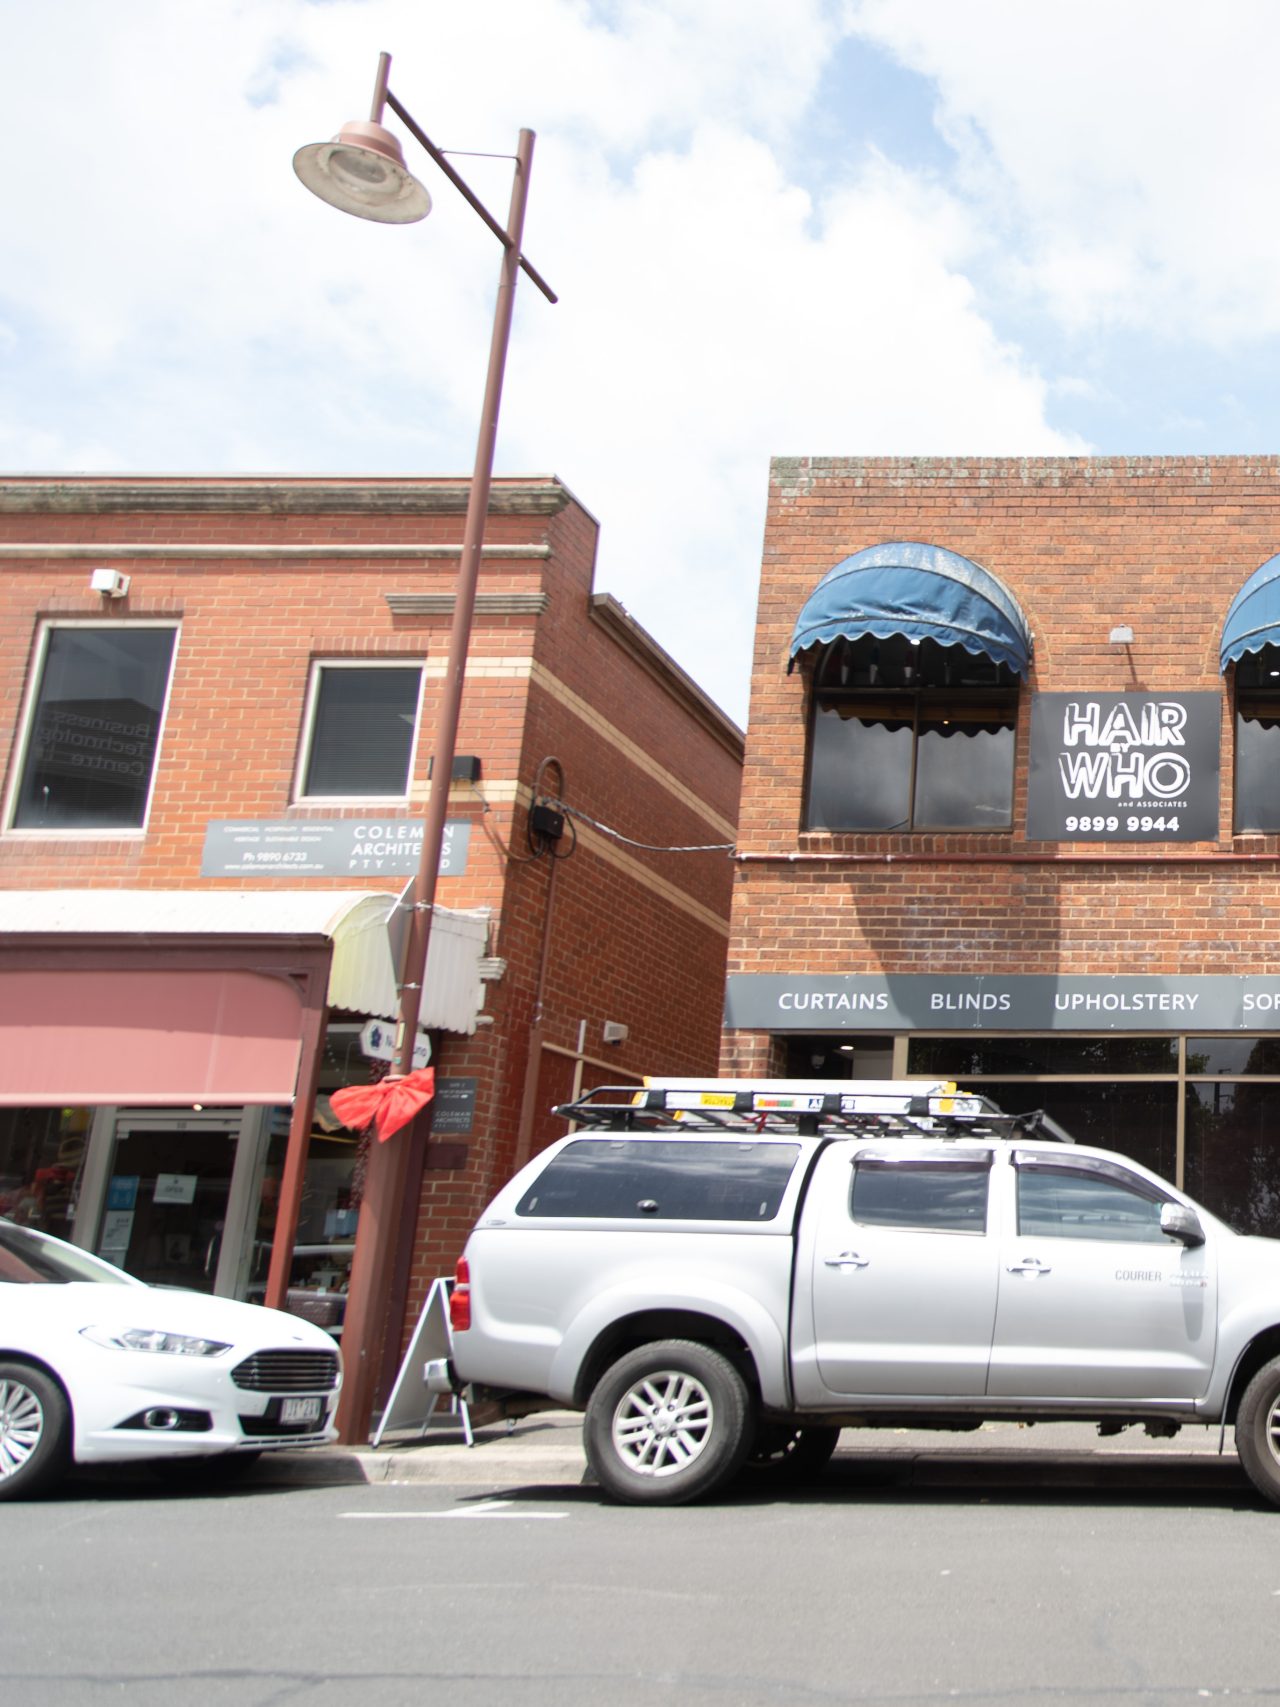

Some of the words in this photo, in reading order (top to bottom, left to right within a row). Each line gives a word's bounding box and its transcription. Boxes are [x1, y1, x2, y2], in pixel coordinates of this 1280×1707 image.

[1063, 702, 1188, 746] HAIR
[1110, 743, 1130, 752] BY
[1058, 752, 1191, 798] WHO
[1065, 816, 1119, 831] 9899
[1126, 816, 1179, 831] 9944
[353, 826, 455, 839] COLEMN
[351, 842, 452, 855] ARCHITES
[243, 852, 256, 862] Ph
[349, 860, 384, 868] PTY
[778, 993, 889, 1010] CURTAINS
[930, 993, 1011, 1010] BLINDS
[1054, 993, 1199, 1010] UPHOLSTERY
[1115, 1270, 1162, 1280] COURIER
